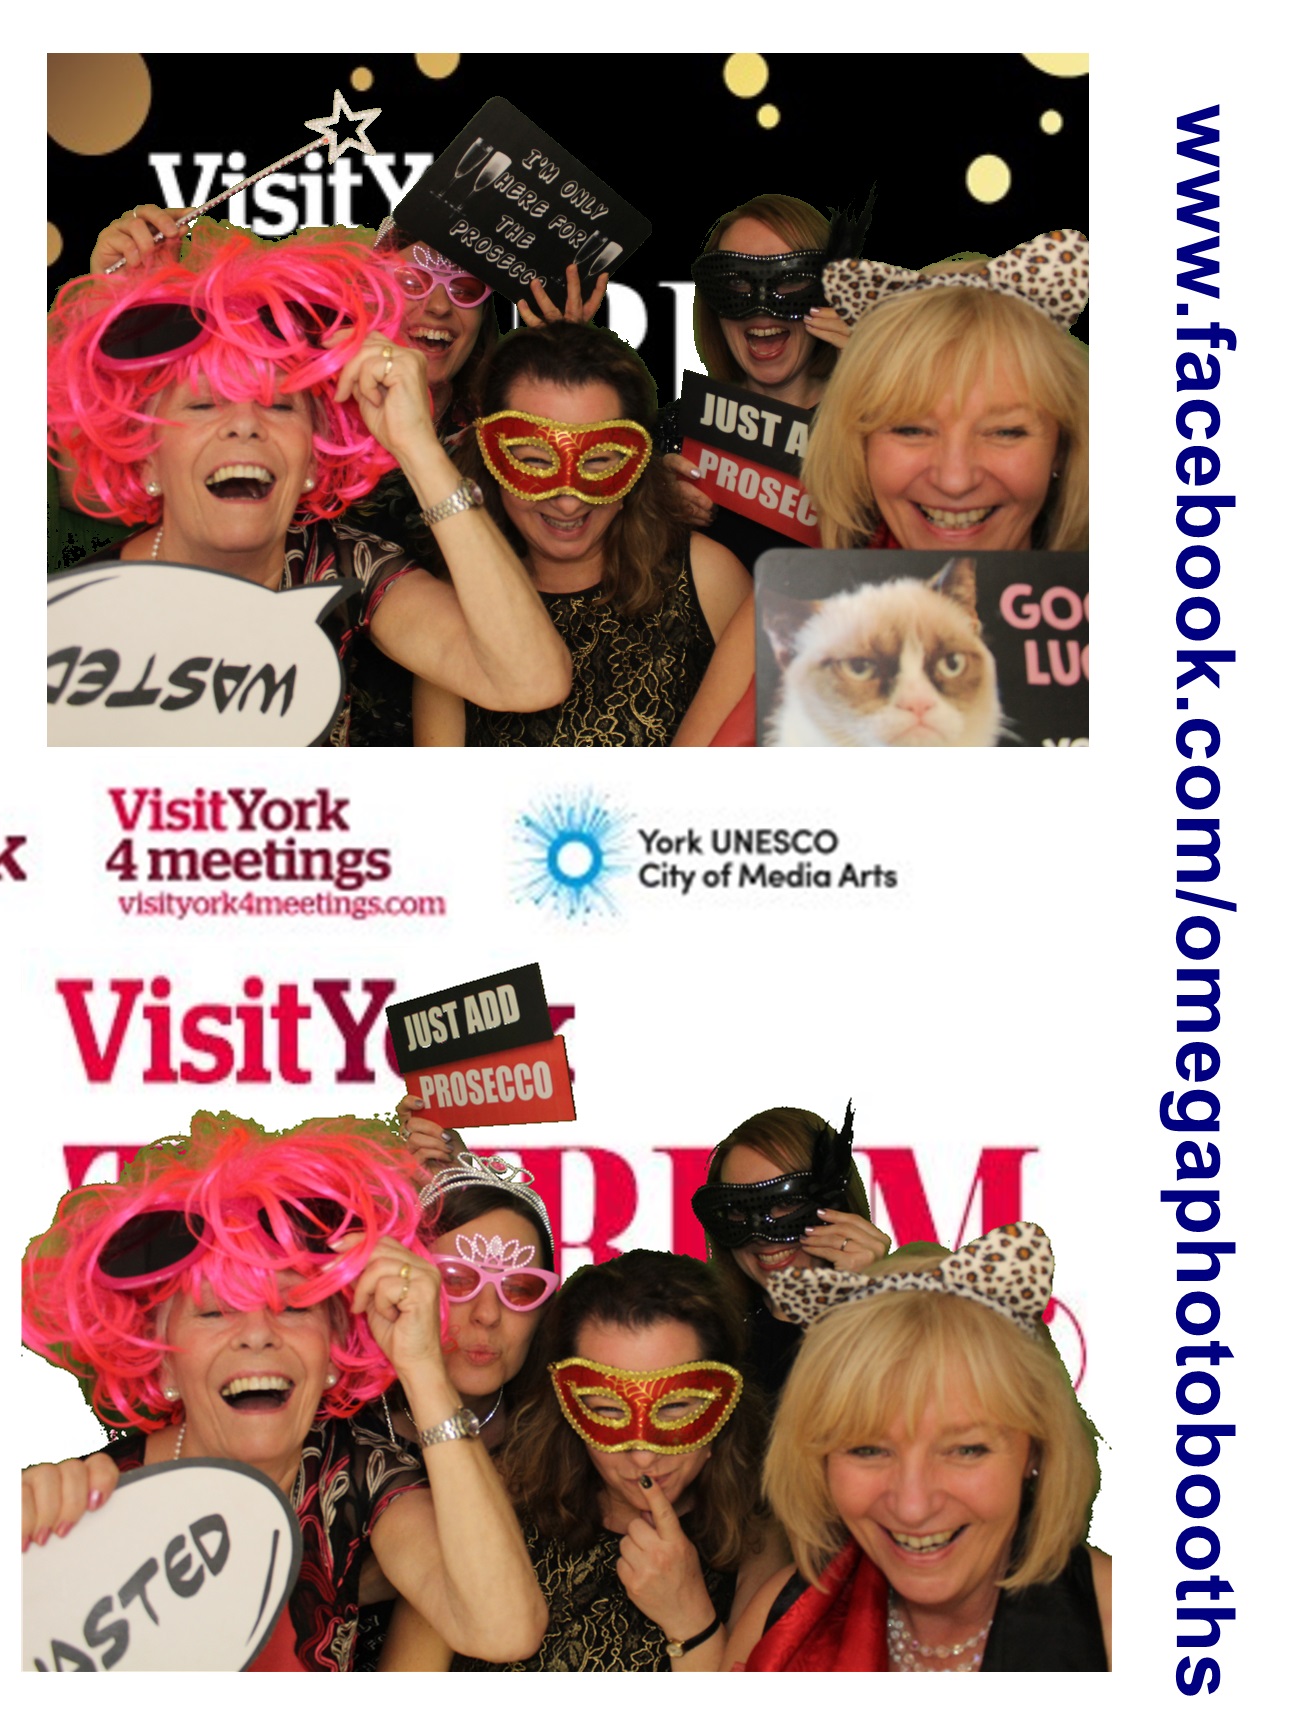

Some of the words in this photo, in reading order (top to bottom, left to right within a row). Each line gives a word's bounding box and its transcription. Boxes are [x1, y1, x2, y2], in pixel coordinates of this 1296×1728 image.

[494, 172, 549, 217] HERE
[548, 215, 587, 248] FOR
[522, 149, 560, 184] I'M
[560, 181, 609, 220] ONLY
[495, 215, 536, 249] THE
[700, 392, 782, 447] JUST
[999, 583, 1089, 631] GO
[1024, 639, 1089, 686] LU
[403, 1001, 461, 1052] JUST
[463, 984, 521, 1035] ADD
[419, 1061, 553, 1109] PROSECCO
[34, 1513, 231, 1672] ASTED
